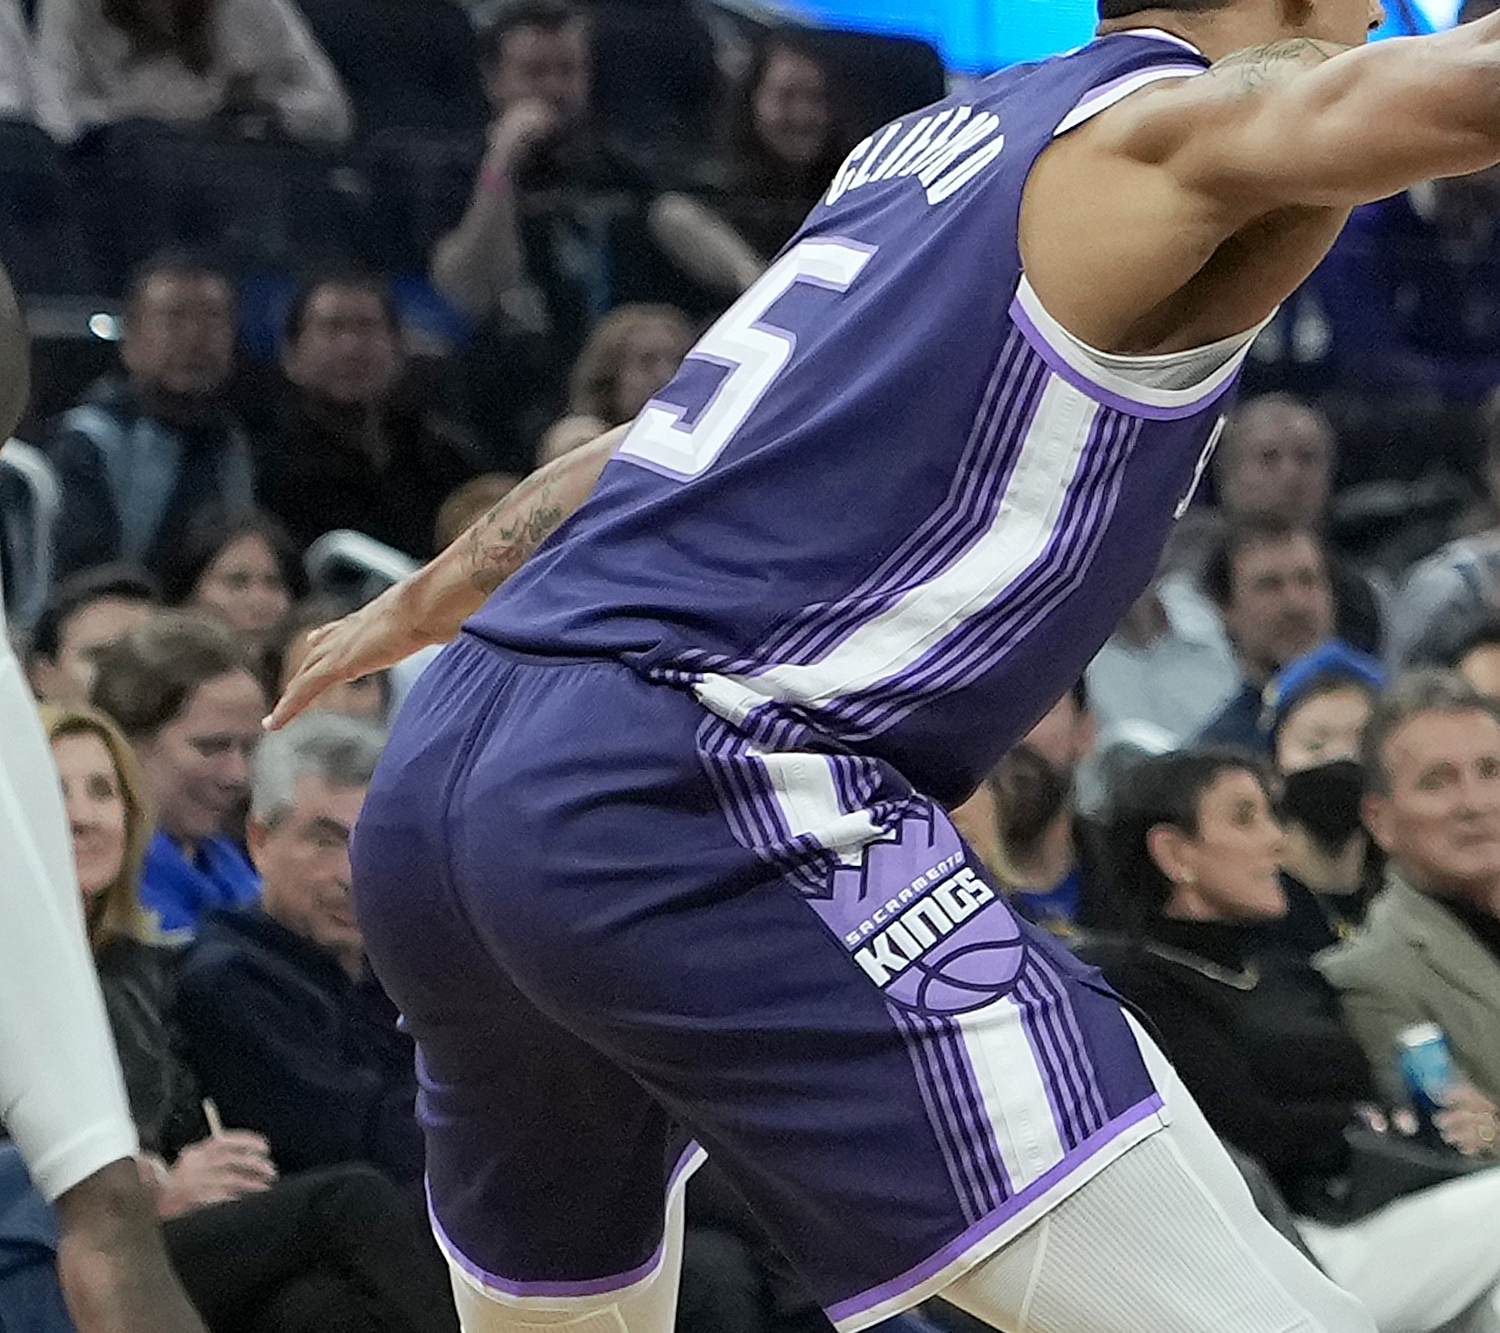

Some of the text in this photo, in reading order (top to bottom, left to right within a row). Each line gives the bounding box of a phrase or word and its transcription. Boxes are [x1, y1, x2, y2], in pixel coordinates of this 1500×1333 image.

[610, 235, 879, 483] 5
[845, 850, 966, 946] SACRAMENTO
[854, 867, 995, 988] KINGS
